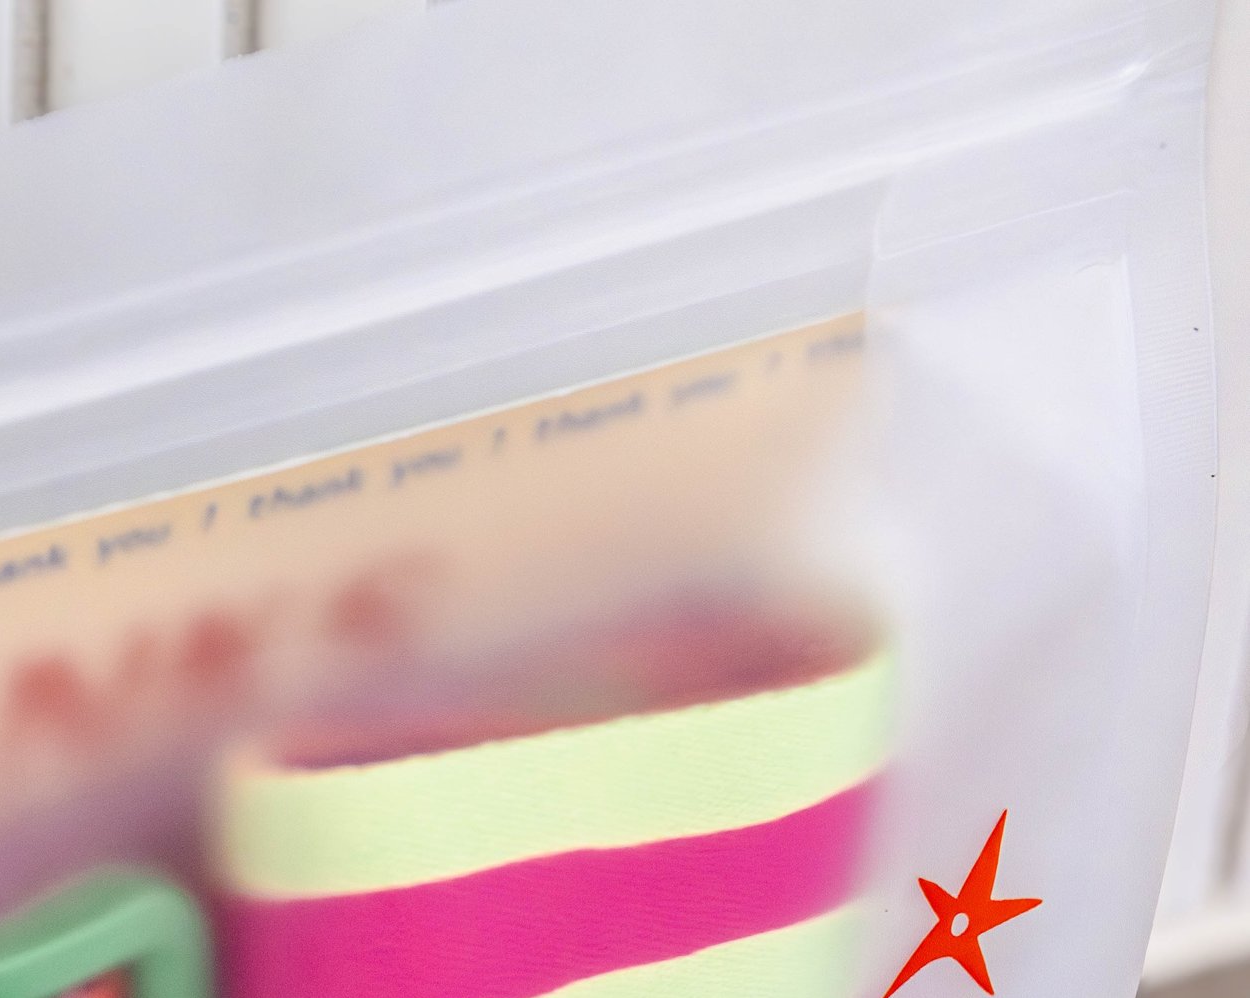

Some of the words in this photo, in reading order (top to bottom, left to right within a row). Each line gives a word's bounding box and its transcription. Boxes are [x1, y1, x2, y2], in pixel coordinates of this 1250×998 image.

[97, 522, 170, 566] you
[247, 466, 364, 519] thank
[389, 446, 464, 487] you
[536, 391, 645, 440] thank
